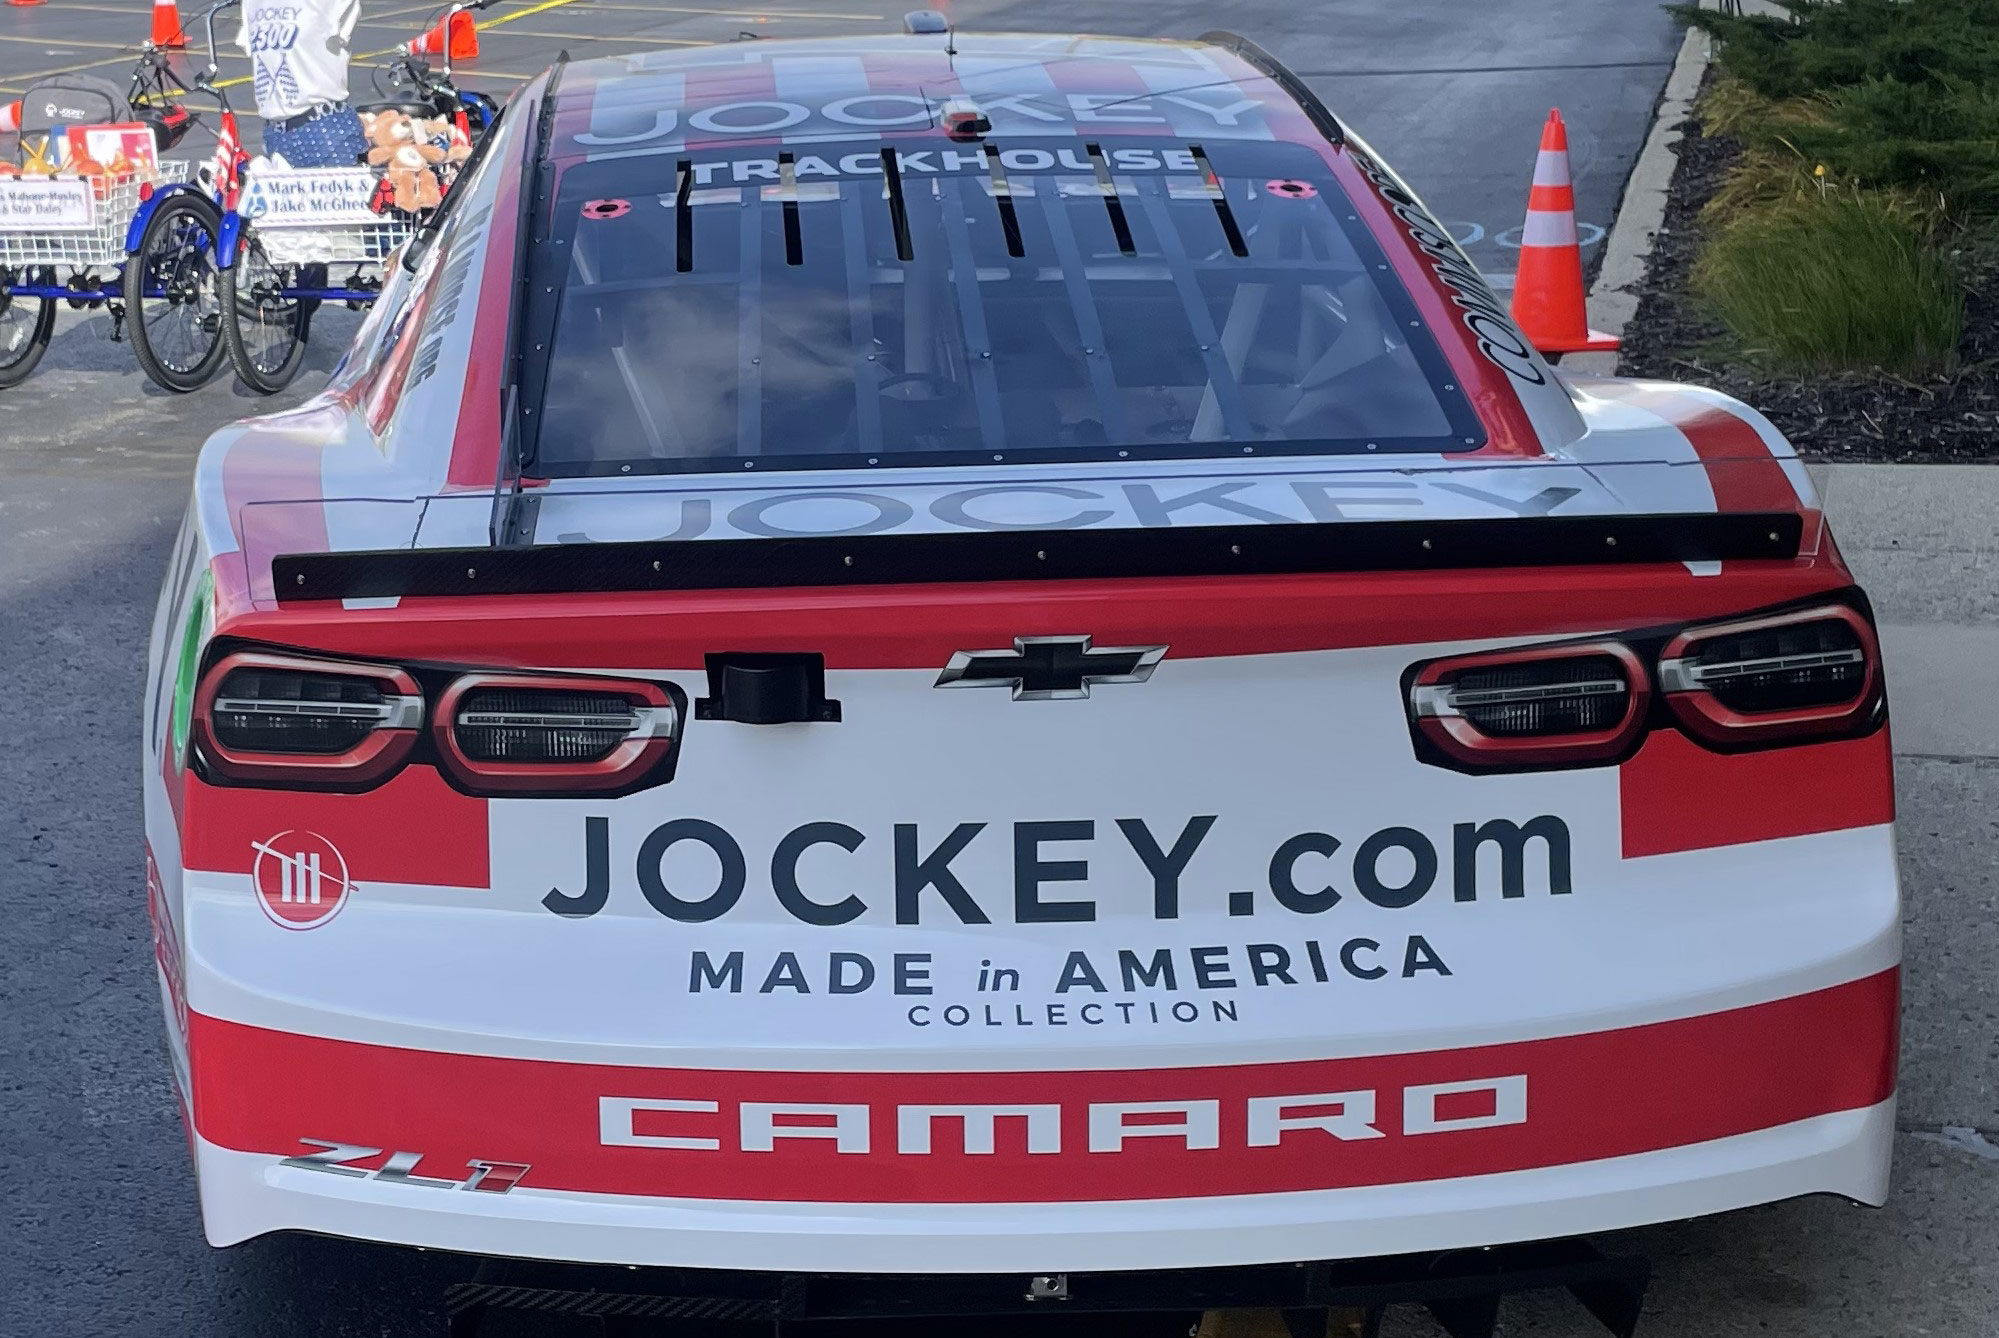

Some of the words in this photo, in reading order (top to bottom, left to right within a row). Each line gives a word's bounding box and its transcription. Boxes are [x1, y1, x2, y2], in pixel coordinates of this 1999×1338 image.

[248, 7, 302, 23] JOCKEY
[250, 24, 300, 52] 2300
[573, 94, 1267, 147] JOCKEY
[268, 181, 305, 194] Mark
[311, 179, 353, 197] Fedyk
[359, 179, 370, 192] &
[688, 148, 1198, 184] TRACKHOUSE
[271, 200, 306, 213] Jake
[554, 481, 1583, 545] JOCKEY
[541, 814, 1573, 926] JOCKEY.com
[688, 950, 935, 996] MADE
[977, 958, 1020, 994] in
[1053, 935, 1454, 994] AMERICA
[907, 1000, 1240, 1027] COLLECTION
[599, 1074, 1529, 1156] CAMARO
[278, 1137, 534, 1195] ZL1
